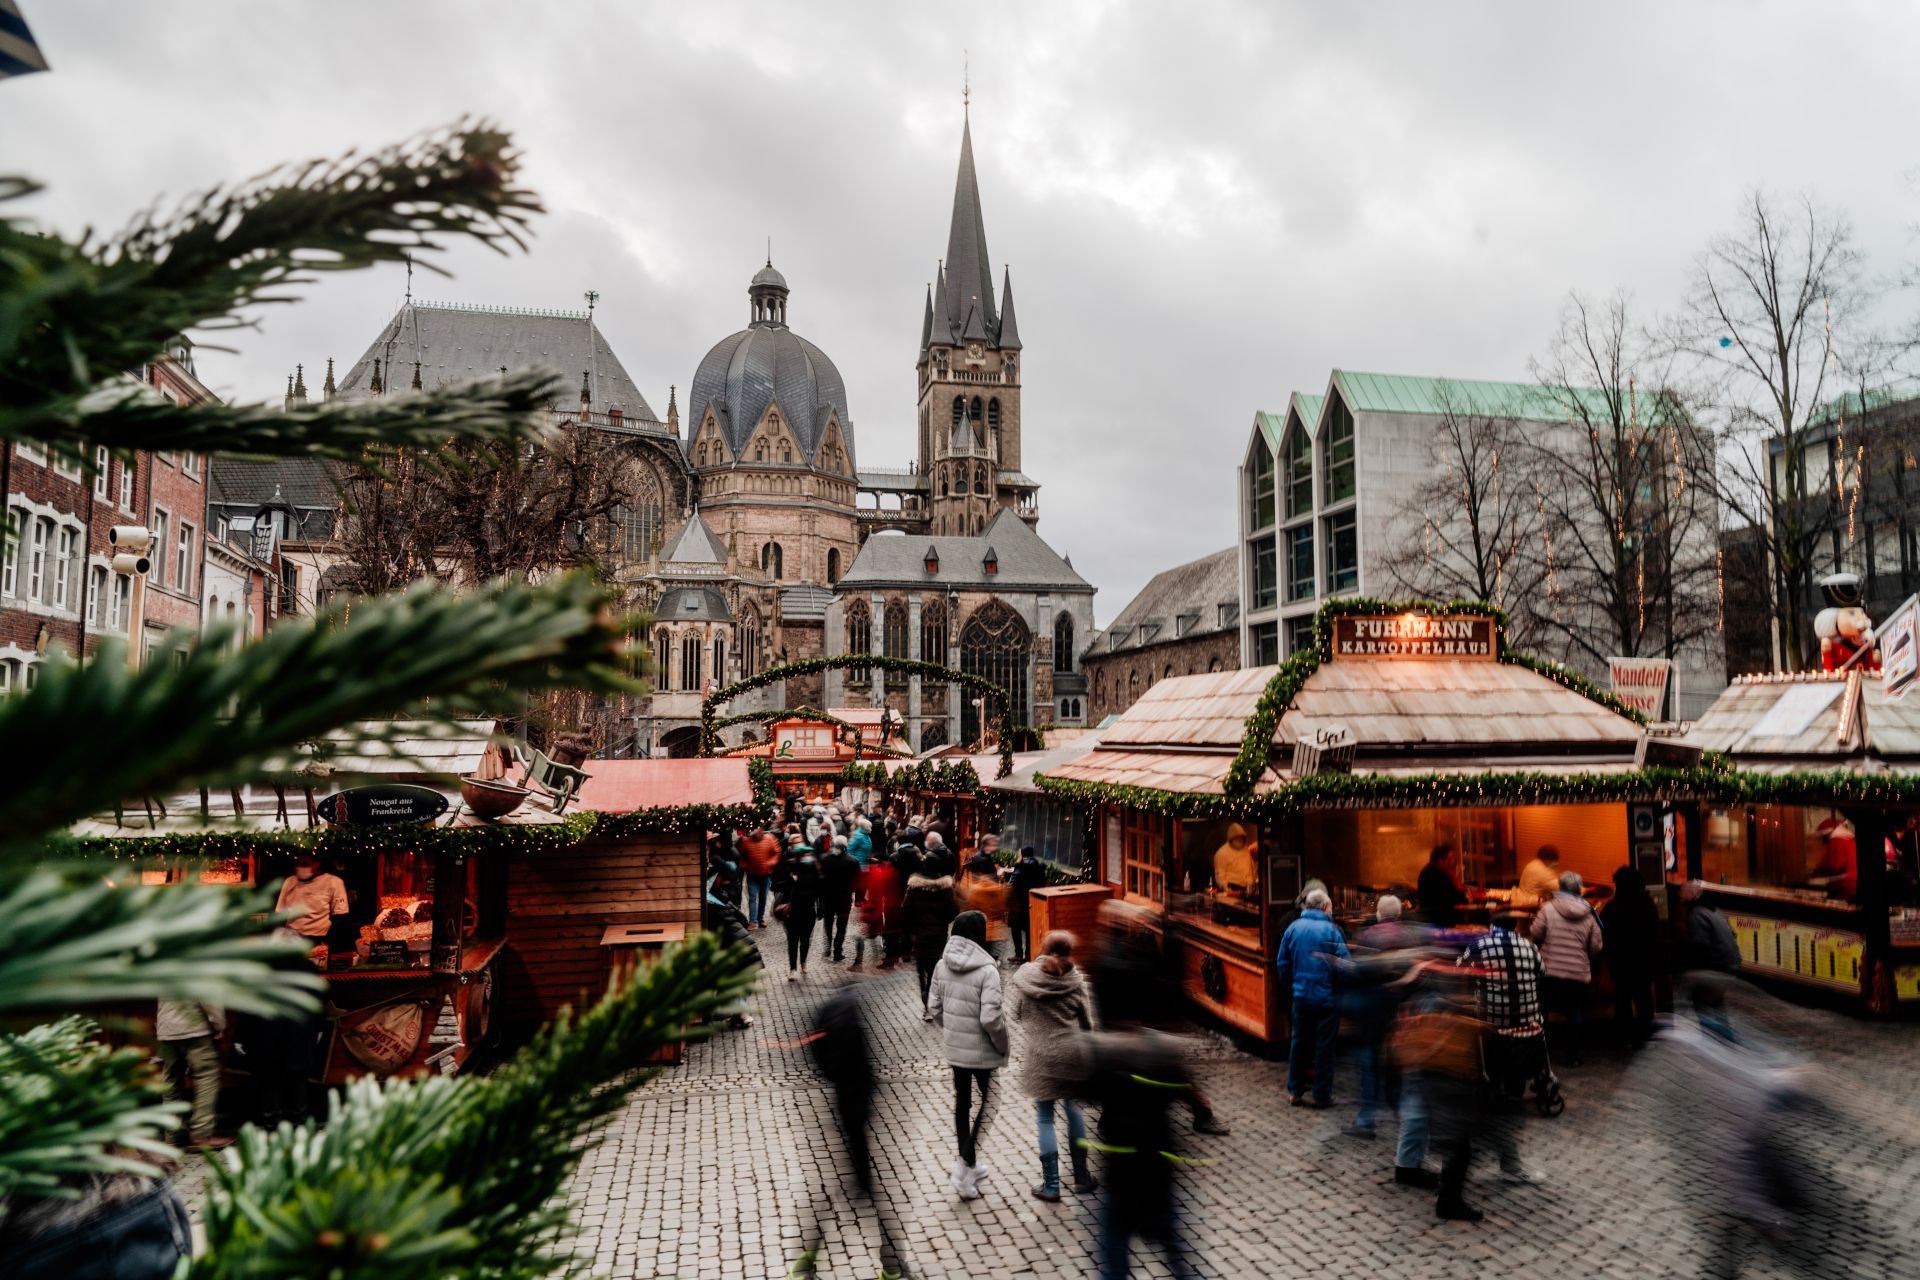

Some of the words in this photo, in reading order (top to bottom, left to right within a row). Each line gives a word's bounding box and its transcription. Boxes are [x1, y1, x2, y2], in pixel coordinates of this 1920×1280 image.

[1354, 620, 1474, 638] FUHRMANN
[1341, 641, 1488, 656] KARTOFFELHAUS
[1612, 664, 1665, 687] Mandeln
[369, 798, 398, 807] Nougat
[371, 806, 413, 816] Frankreich
[366, 1023, 410, 1058] CHRISTMAS
